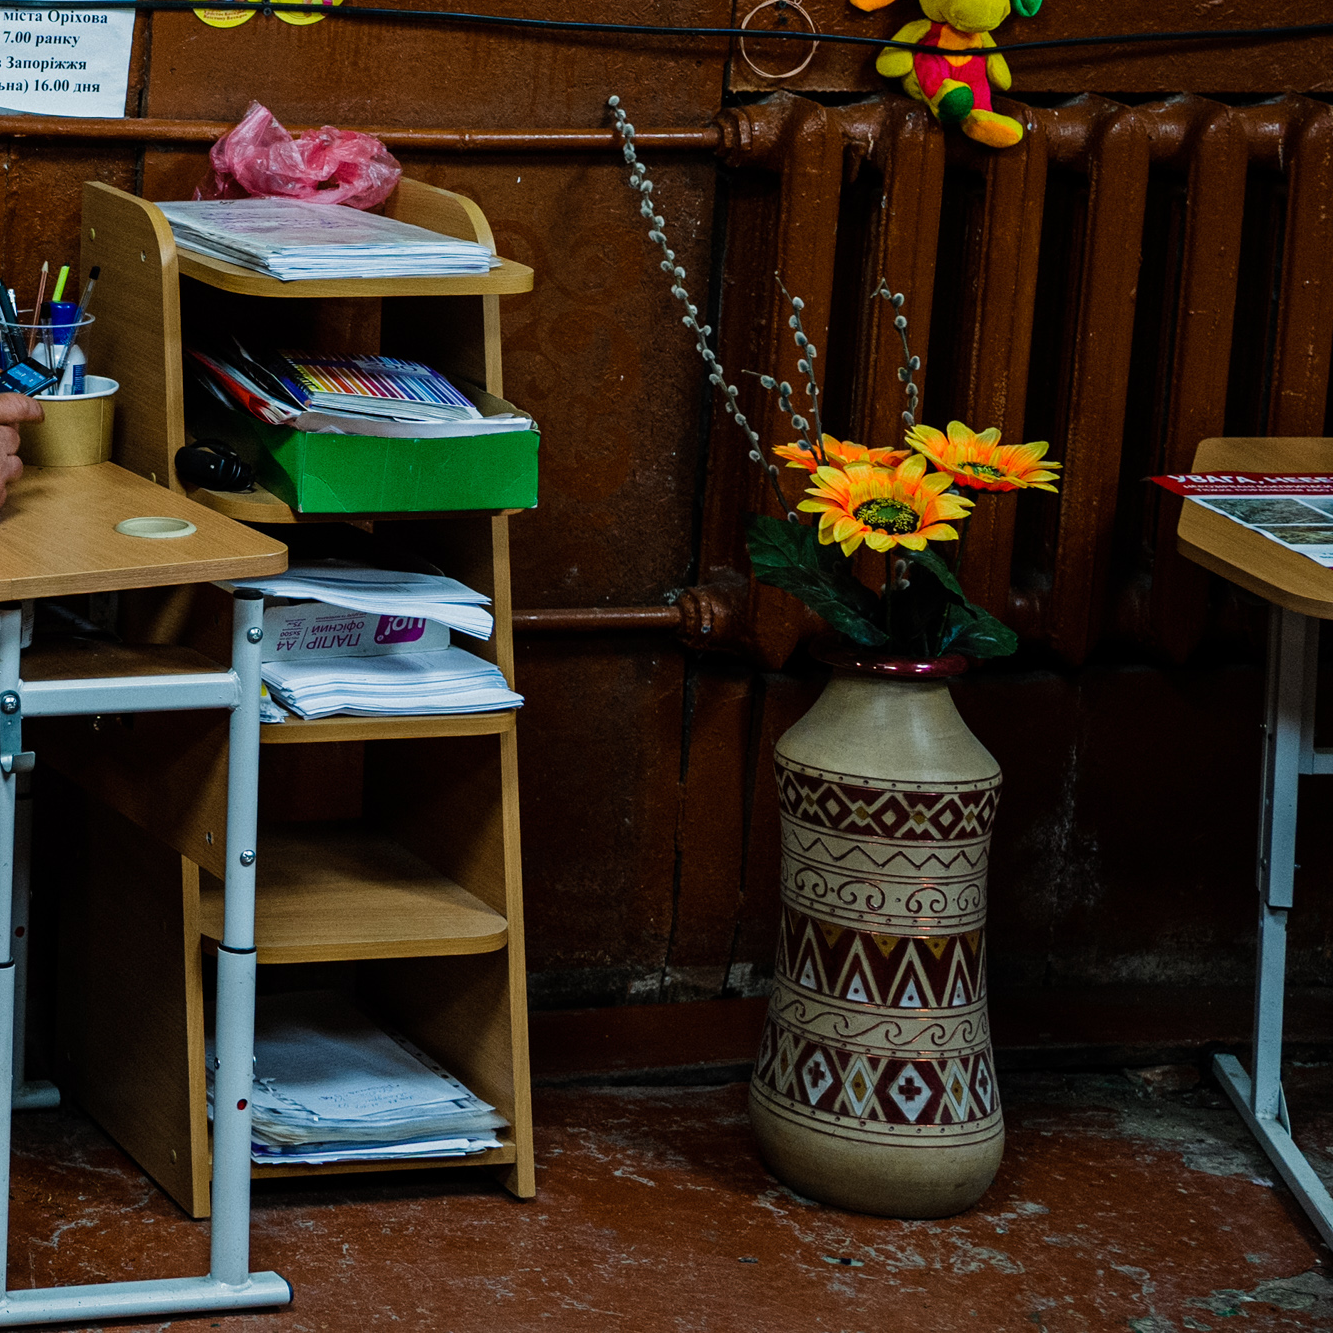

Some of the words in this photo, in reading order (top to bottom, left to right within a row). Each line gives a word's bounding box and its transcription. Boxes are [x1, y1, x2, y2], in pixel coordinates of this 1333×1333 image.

[3, 9, 43, 22] міста
[47, 9, 108, 26] Оріхова
[3, 31, 31, 44] 7.00
[35, 33, 81, 47] ранку
[6, 56, 87, 72] Запоріжжя
[33, 79, 69, 92] 16.00
[73, 82, 101, 93] дня
[311, 621, 365, 639] офісний
[306, 632, 361, 651] ПАПІР
